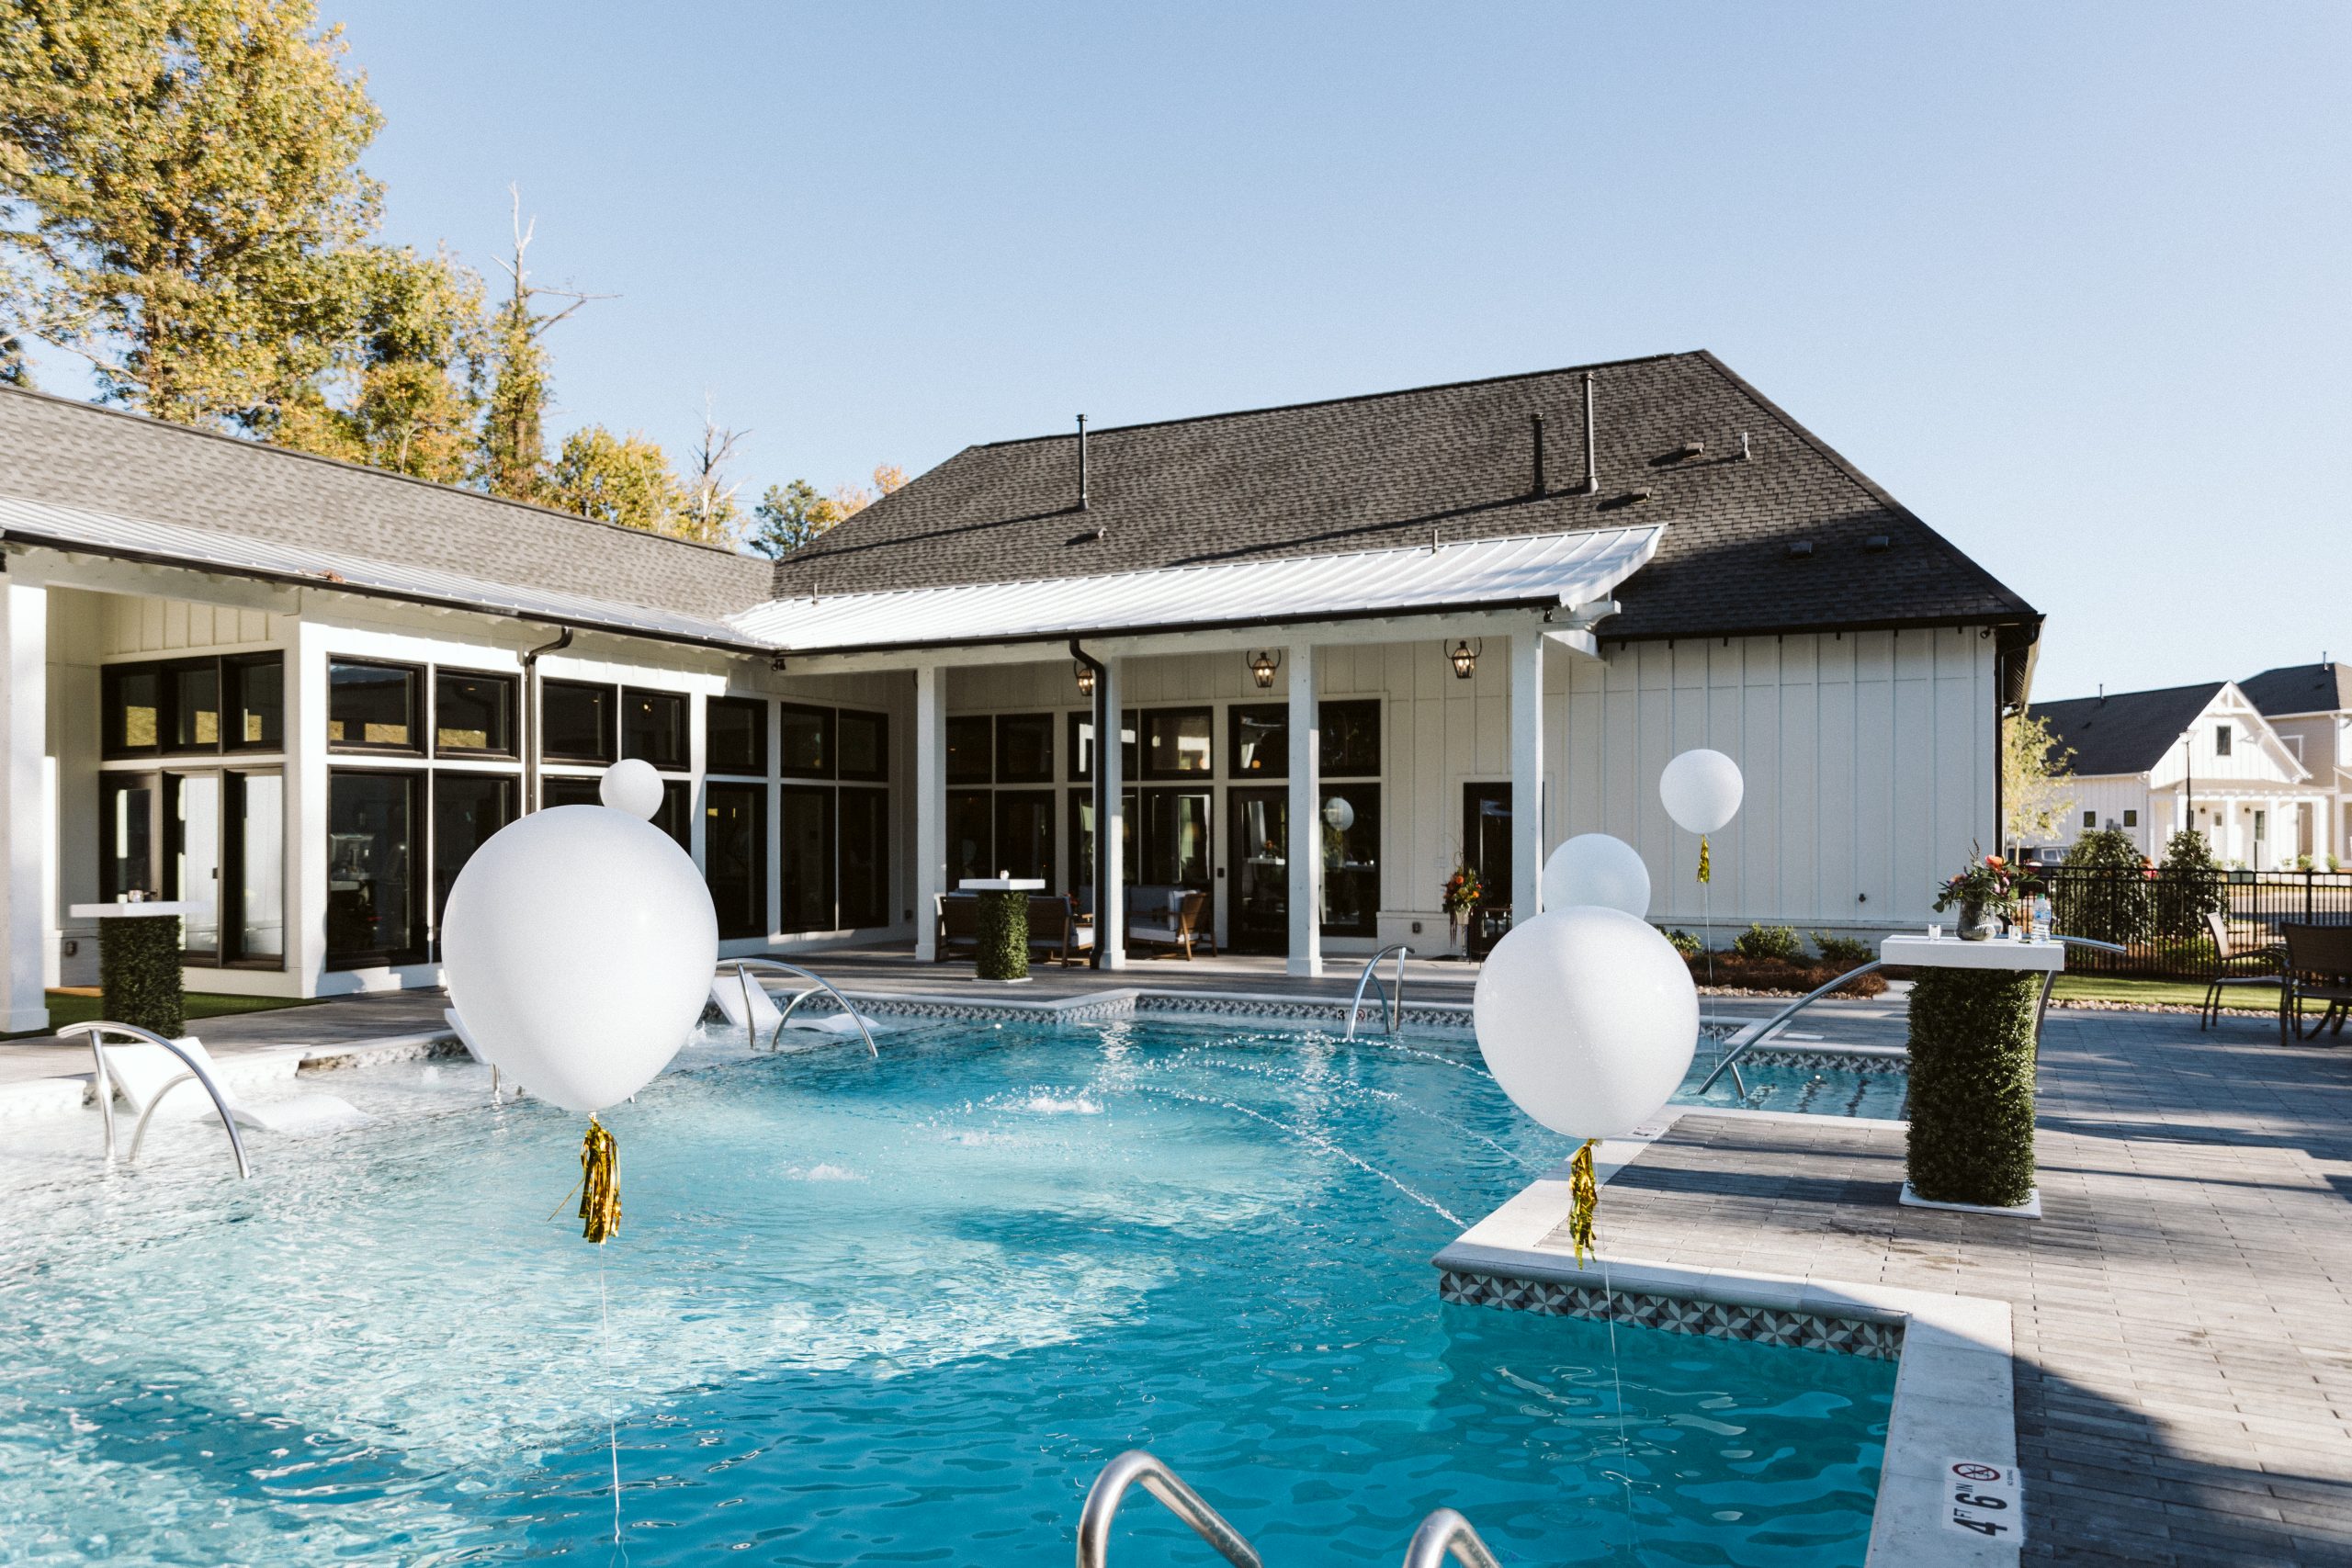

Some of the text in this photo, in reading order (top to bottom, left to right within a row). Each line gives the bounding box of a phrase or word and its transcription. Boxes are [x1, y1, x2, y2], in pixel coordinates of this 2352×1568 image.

[1338, 1009, 1345, 1020] 3
[1953, 1483, 2007, 1536] 4 FT 6 IN
